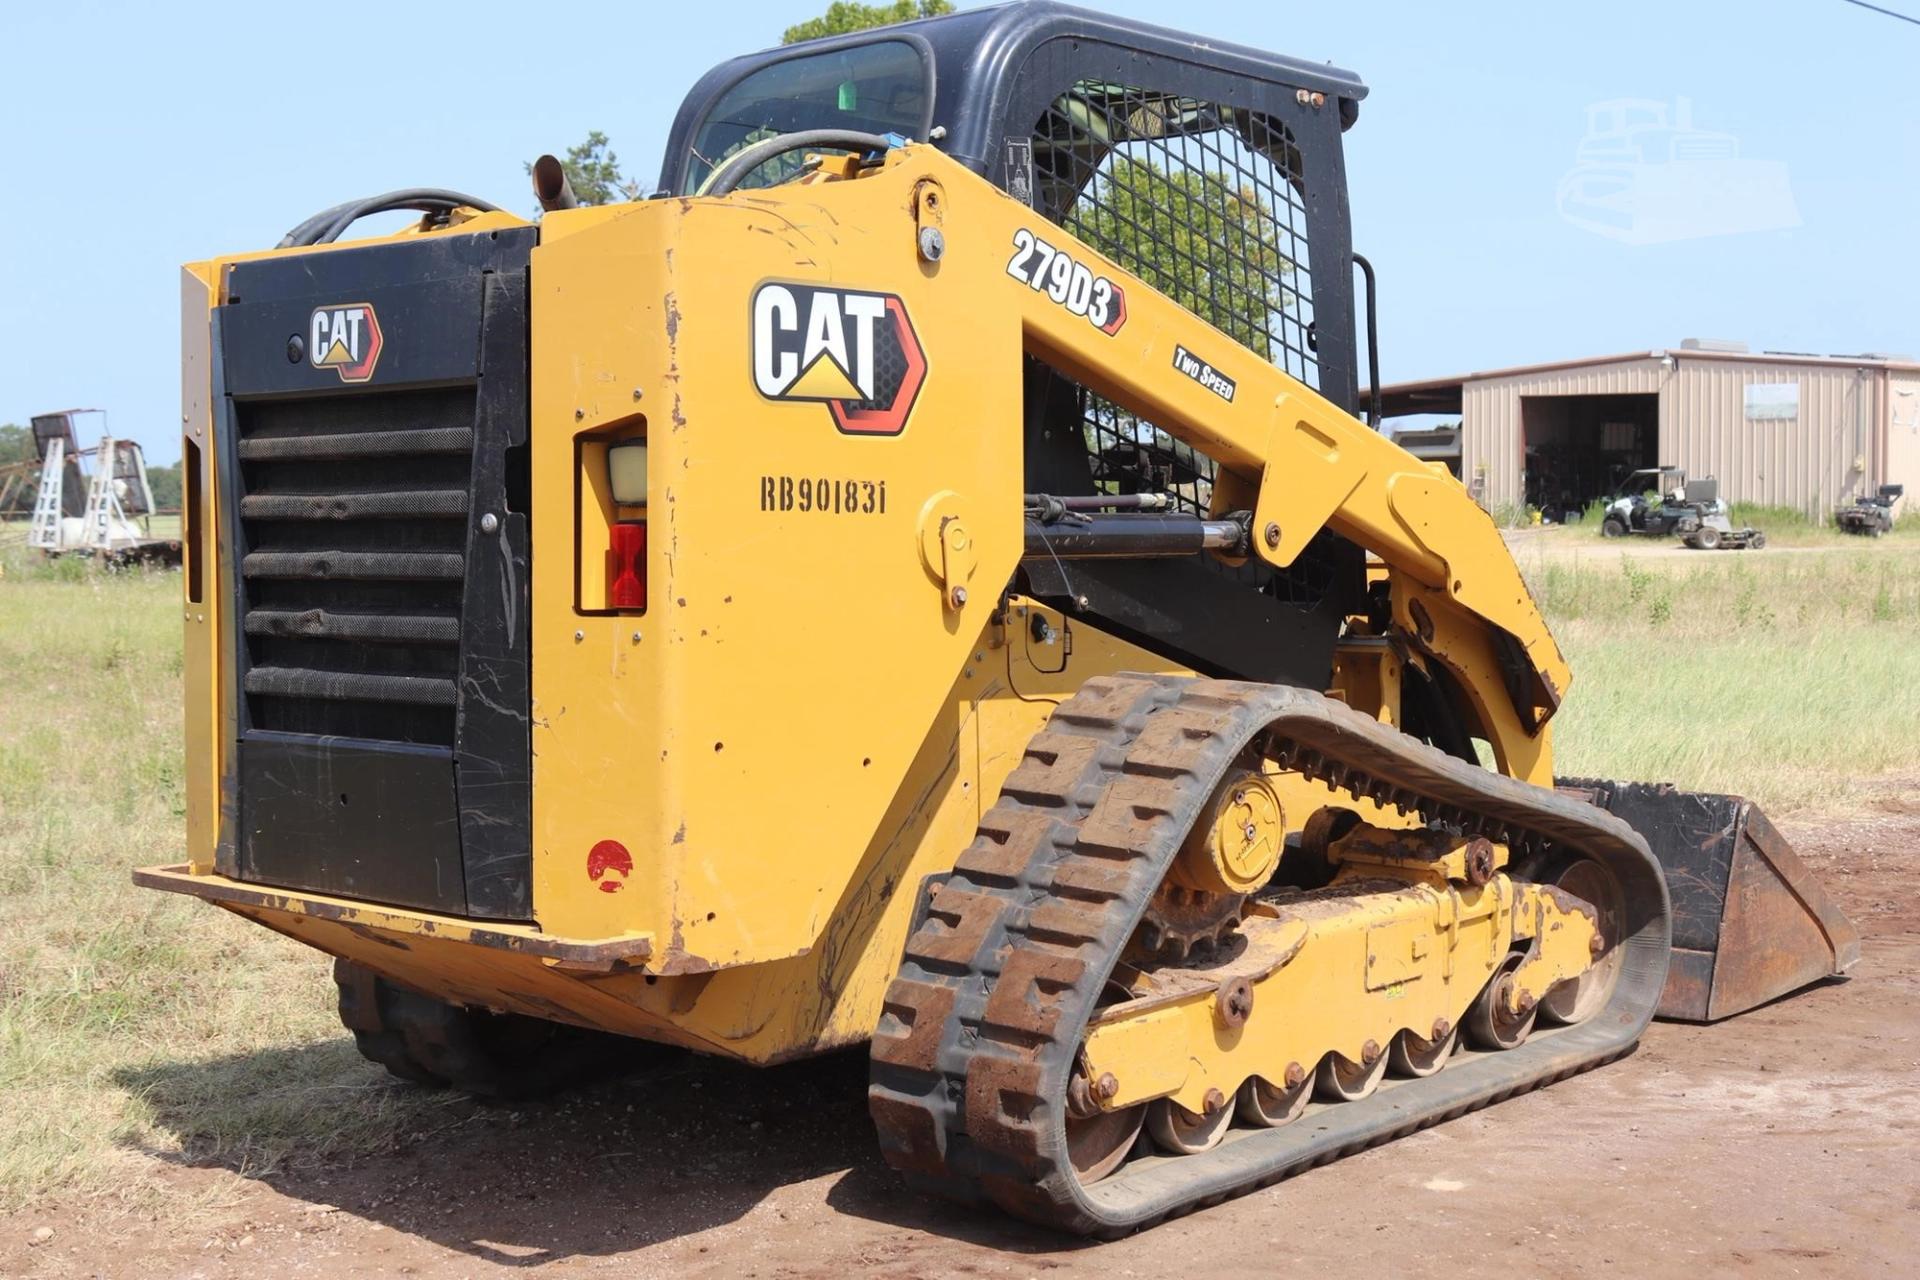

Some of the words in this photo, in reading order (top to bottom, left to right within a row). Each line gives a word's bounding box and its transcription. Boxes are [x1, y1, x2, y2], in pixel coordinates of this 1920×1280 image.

[1006, 228, 1113, 328] 279D3
[312, 308, 364, 365] CAT
[754, 285, 886, 401] CAT
[760, 476, 886, 514] RB901831
